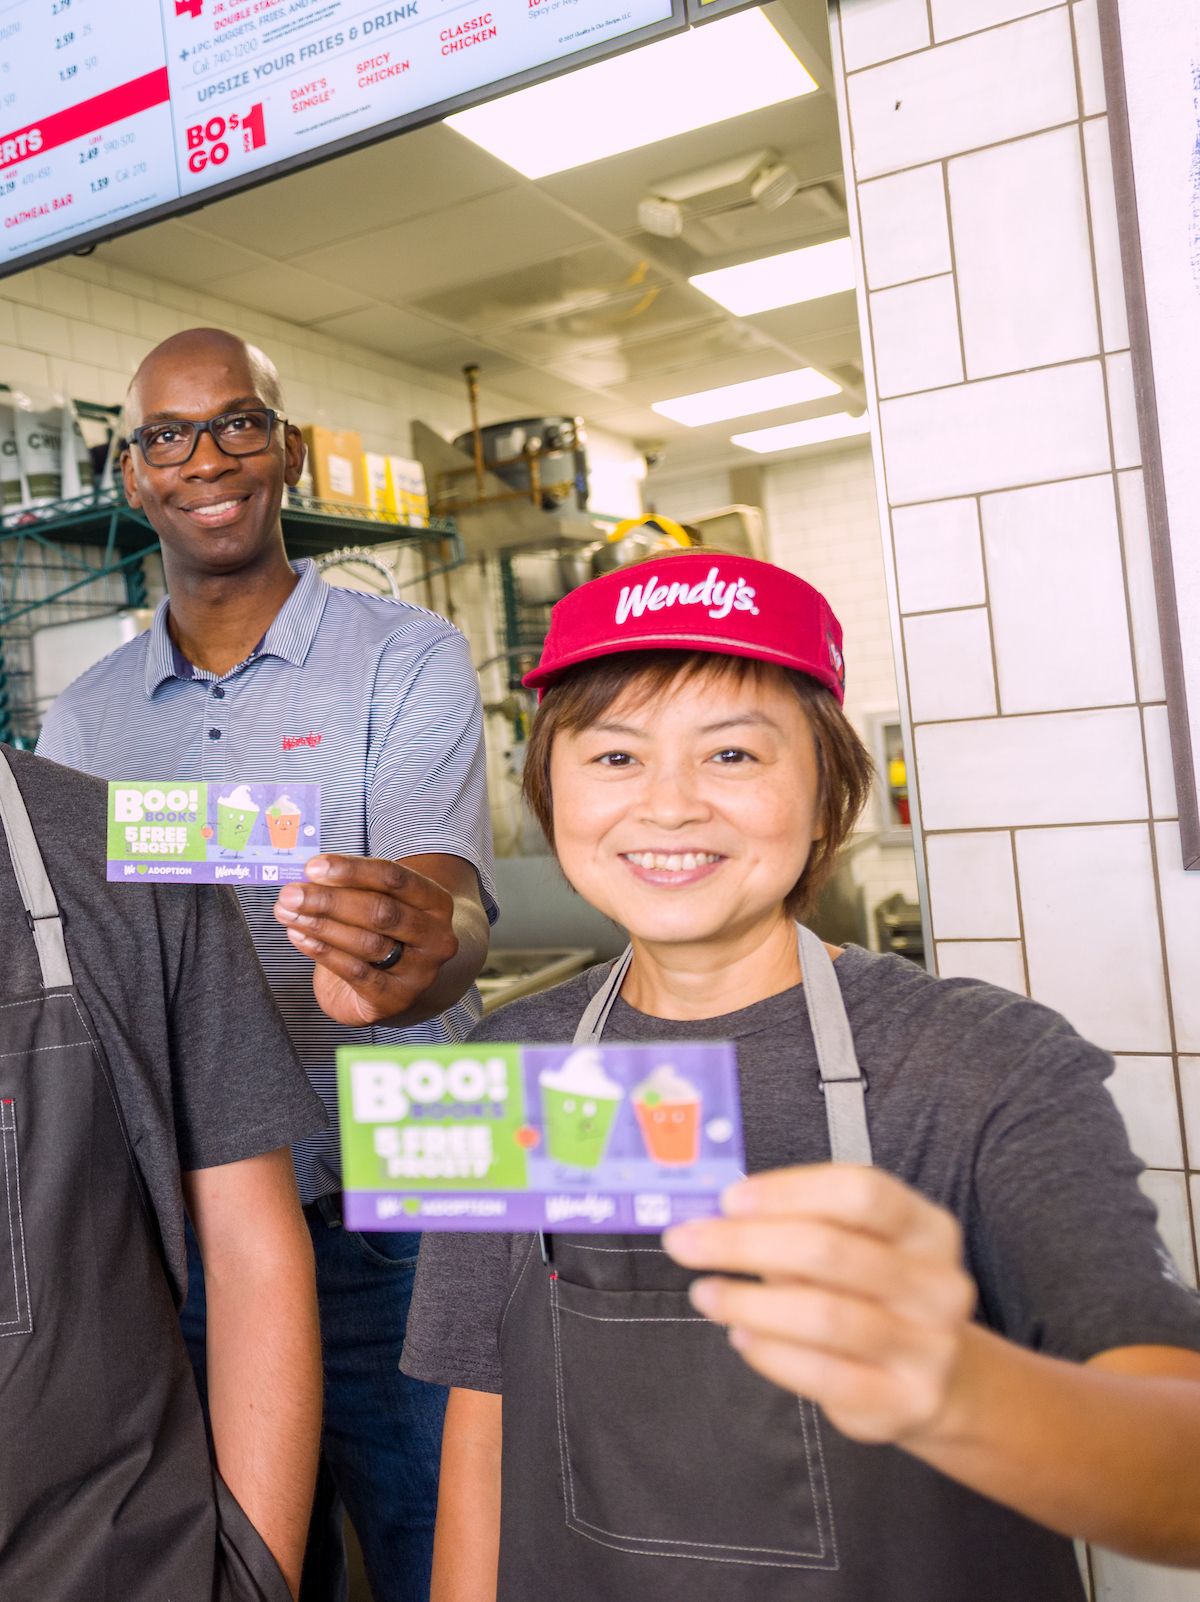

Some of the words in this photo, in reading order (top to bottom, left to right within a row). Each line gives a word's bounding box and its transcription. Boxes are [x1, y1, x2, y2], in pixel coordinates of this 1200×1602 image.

[214, 7, 252, 31] DOUBLE
[528, 5, 550, 20] Spicy
[552, 1, 560, 11] or
[622, 12, 632, 20] LLC
[440, 13, 494, 42] CLASSIC
[197, 71, 250, 102] UPSIZE
[253, 52, 295, 80] YOUR
[300, 32, 344, 62] FRIES
[348, 26, 358, 41] &
[362, 1, 418, 36] DRINK
[441, 26, 498, 57] CHICKEN
[356, 52, 392, 74] SPICY
[358, 60, 410, 89] CHICKEN
[290, 78, 328, 101] DAVE'S
[292, 91, 331, 114] SINGLE
[3, 203, 50, 229] OATMEAL
[52, 193, 73, 211] BAR
[615, 567, 759, 625] Wendy's
[115, 789, 198, 823] BOO!
[145, 811, 196, 823] BOOKS
[125, 826, 138, 842] 5
[140, 826, 187, 842] FREE
[131, 841, 186, 854] FROSTY
[124, 864, 136, 876] We
[148, 866, 192, 875] ADOPTION
[215, 864, 250, 879] Wendy's
[351, 1057, 509, 1124] BOO!
